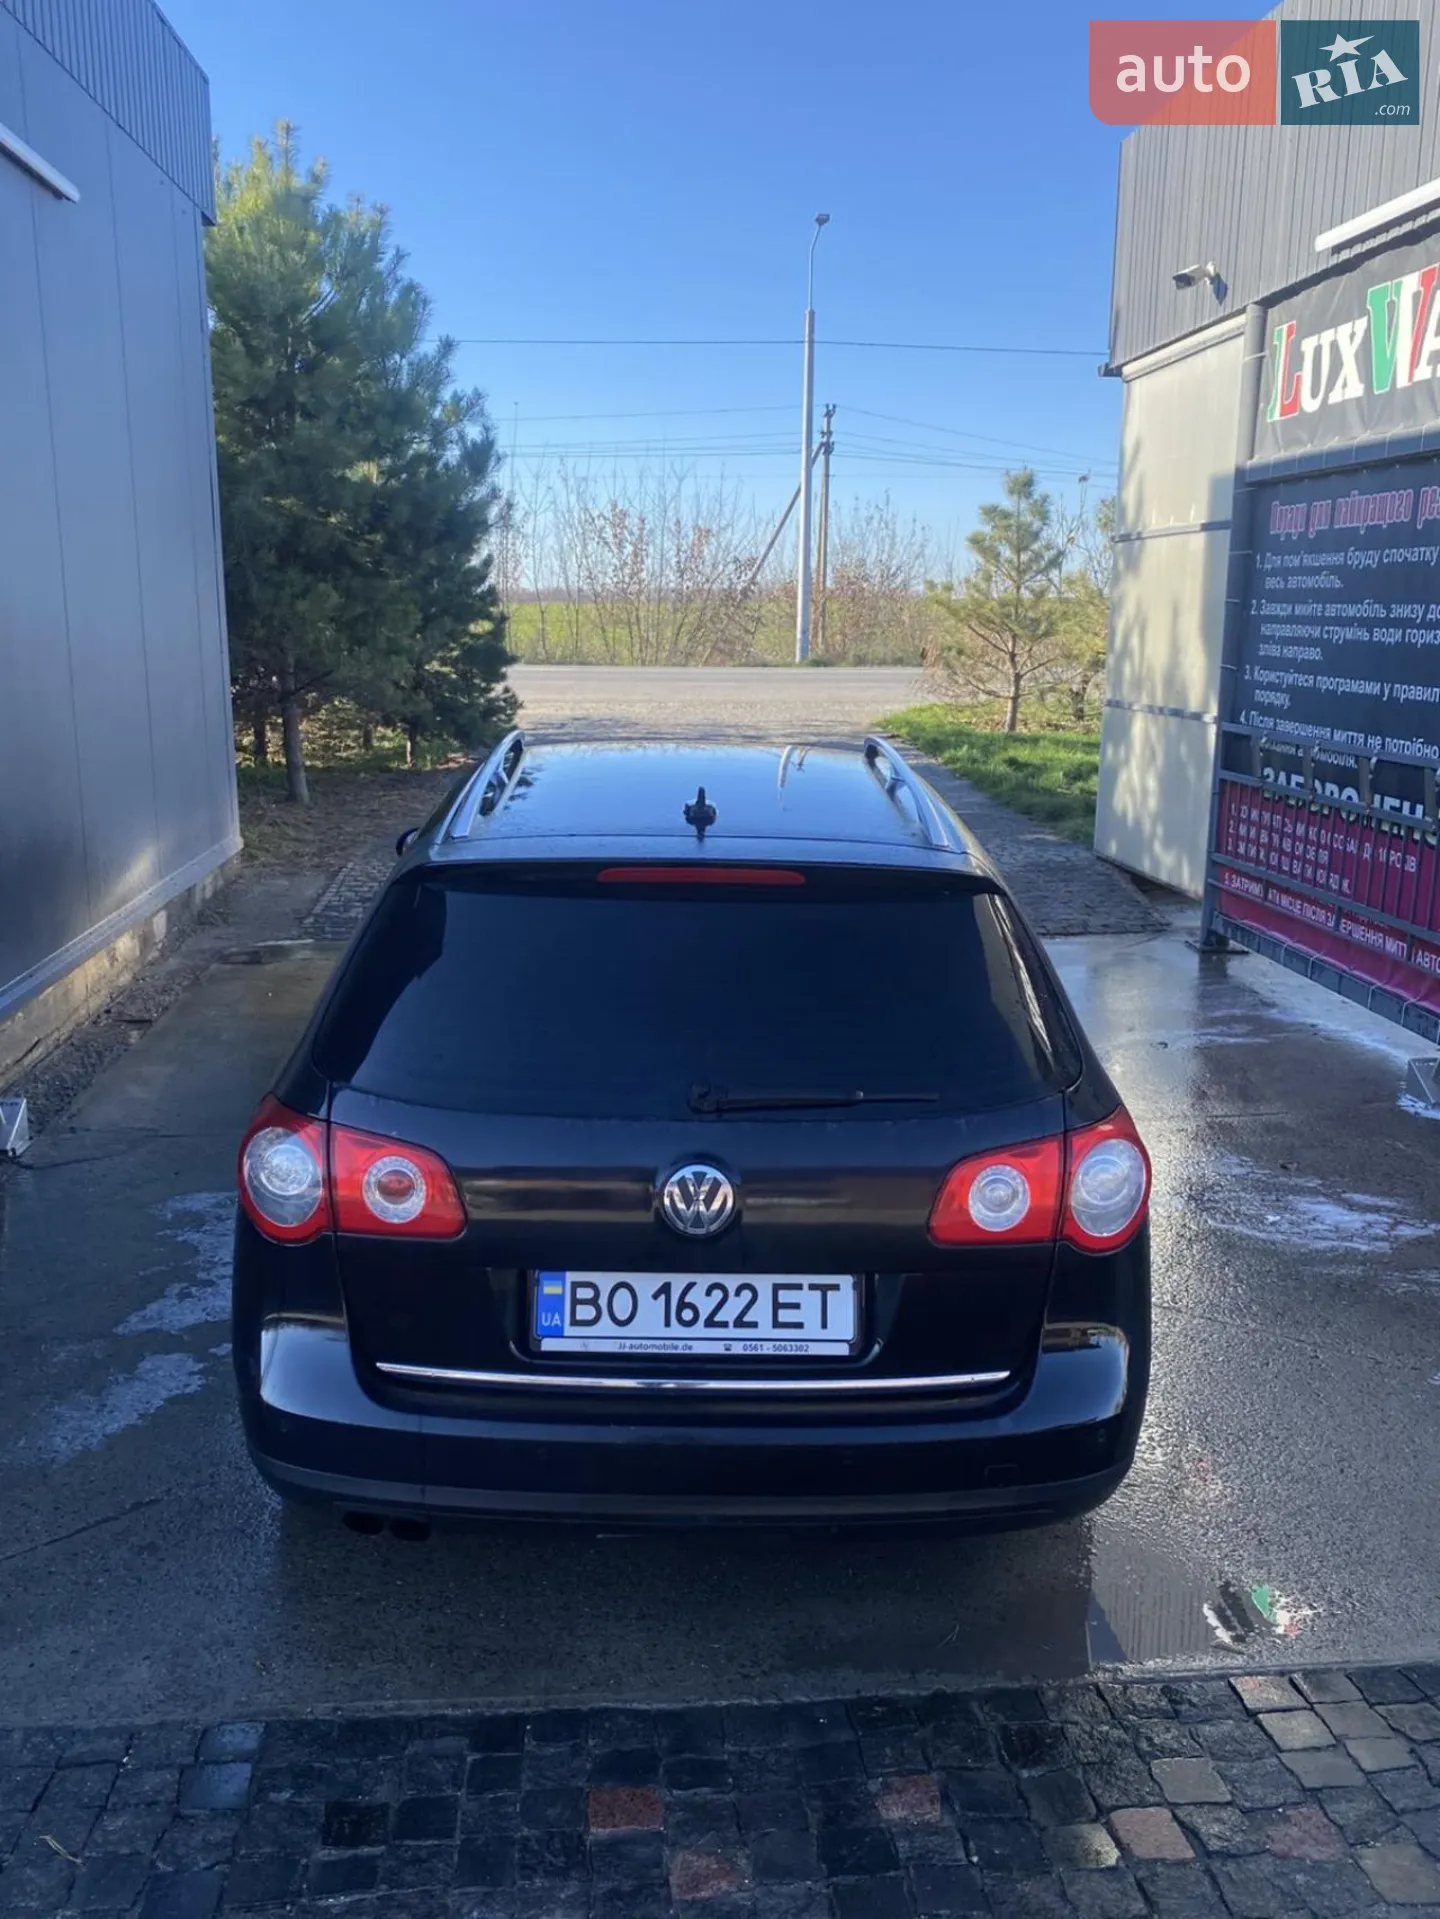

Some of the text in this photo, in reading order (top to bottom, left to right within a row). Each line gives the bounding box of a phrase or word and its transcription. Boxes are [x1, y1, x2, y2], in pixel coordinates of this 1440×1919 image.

[1347, 547, 1381, 569] бруду
[1383, 545, 1440, 567] спочатку
[1324, 600, 1386, 618] автомобіль
[1389, 603, 1425, 624] знизу
[1323, 622, 1370, 644] струмінь
[1373, 627, 1402, 646] води
[1316, 675, 1381, 696] програмами
[1383, 682, 1391, 701] у
[1393, 683, 1440, 704] правил
[1333, 728, 1365, 748] миття
[1367, 733, 1381, 749] не
[652, 1281, 759, 1330] 1622
[772, 1282, 841, 1330] ET
[541, 1312, 562, 1327] UA
